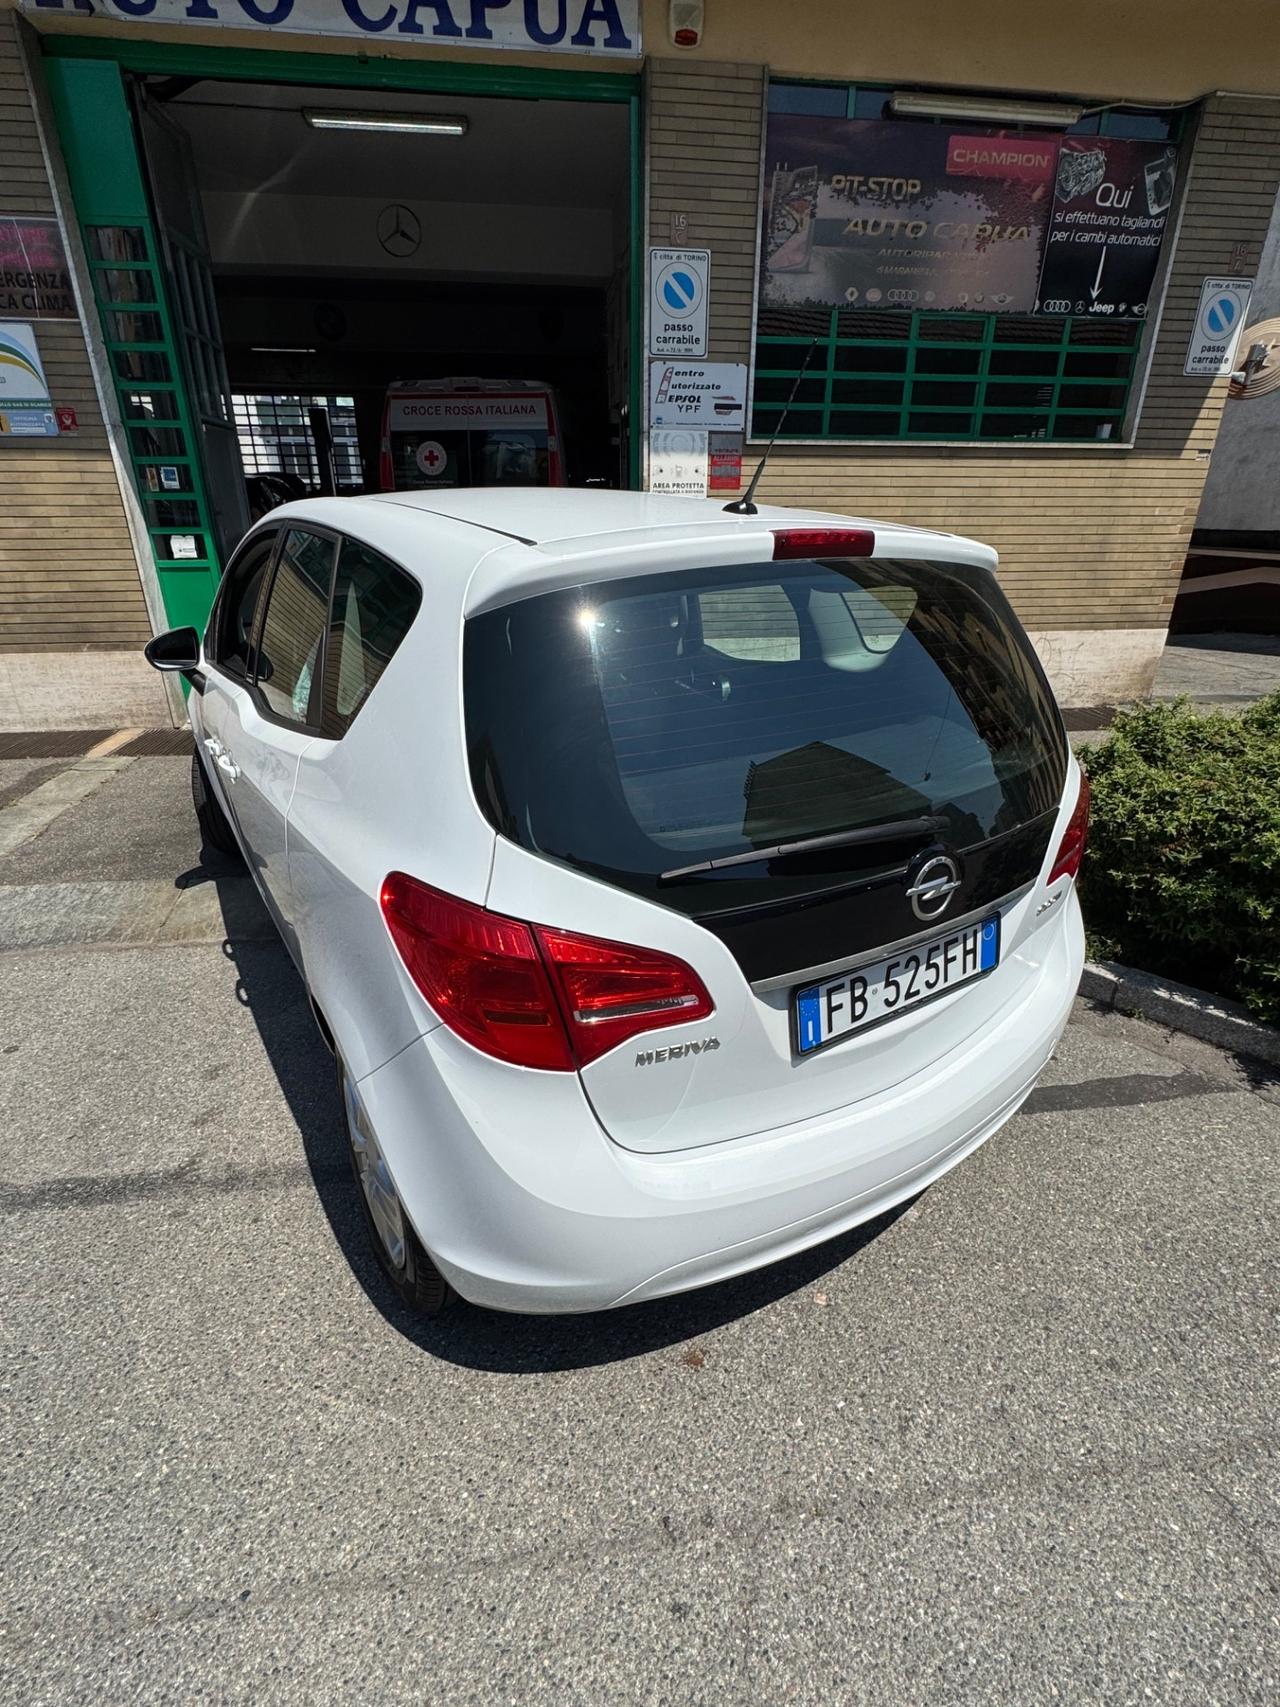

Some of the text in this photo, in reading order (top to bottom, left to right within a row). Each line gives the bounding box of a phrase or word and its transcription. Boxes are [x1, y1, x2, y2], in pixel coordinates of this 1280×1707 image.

[953, 149, 1049, 168] CHAMPION
[1096, 183, 1134, 208] Qui
[843, 218, 927, 237] AUTO
[1054, 211, 1165, 230] si effettuano tagliandi
[1050, 231, 1070, 243] per
[1075, 231, 1107, 243] cambi
[1108, 234, 1161, 246] automatici
[1089, 301, 1115, 314] Jeep
[664, 323, 693, 333] passo
[656, 335, 700, 345] carrabile
[1201, 345, 1226, 353] passo
[1192, 354, 1229, 364] carrabile
[402, 404, 537, 416] CROCE ROSSA ITALIANA
[826, 975, 868, 1034] FB
[884, 929, 978, 1008] 525FH
[634, 1036, 720, 1067] MERIVA
